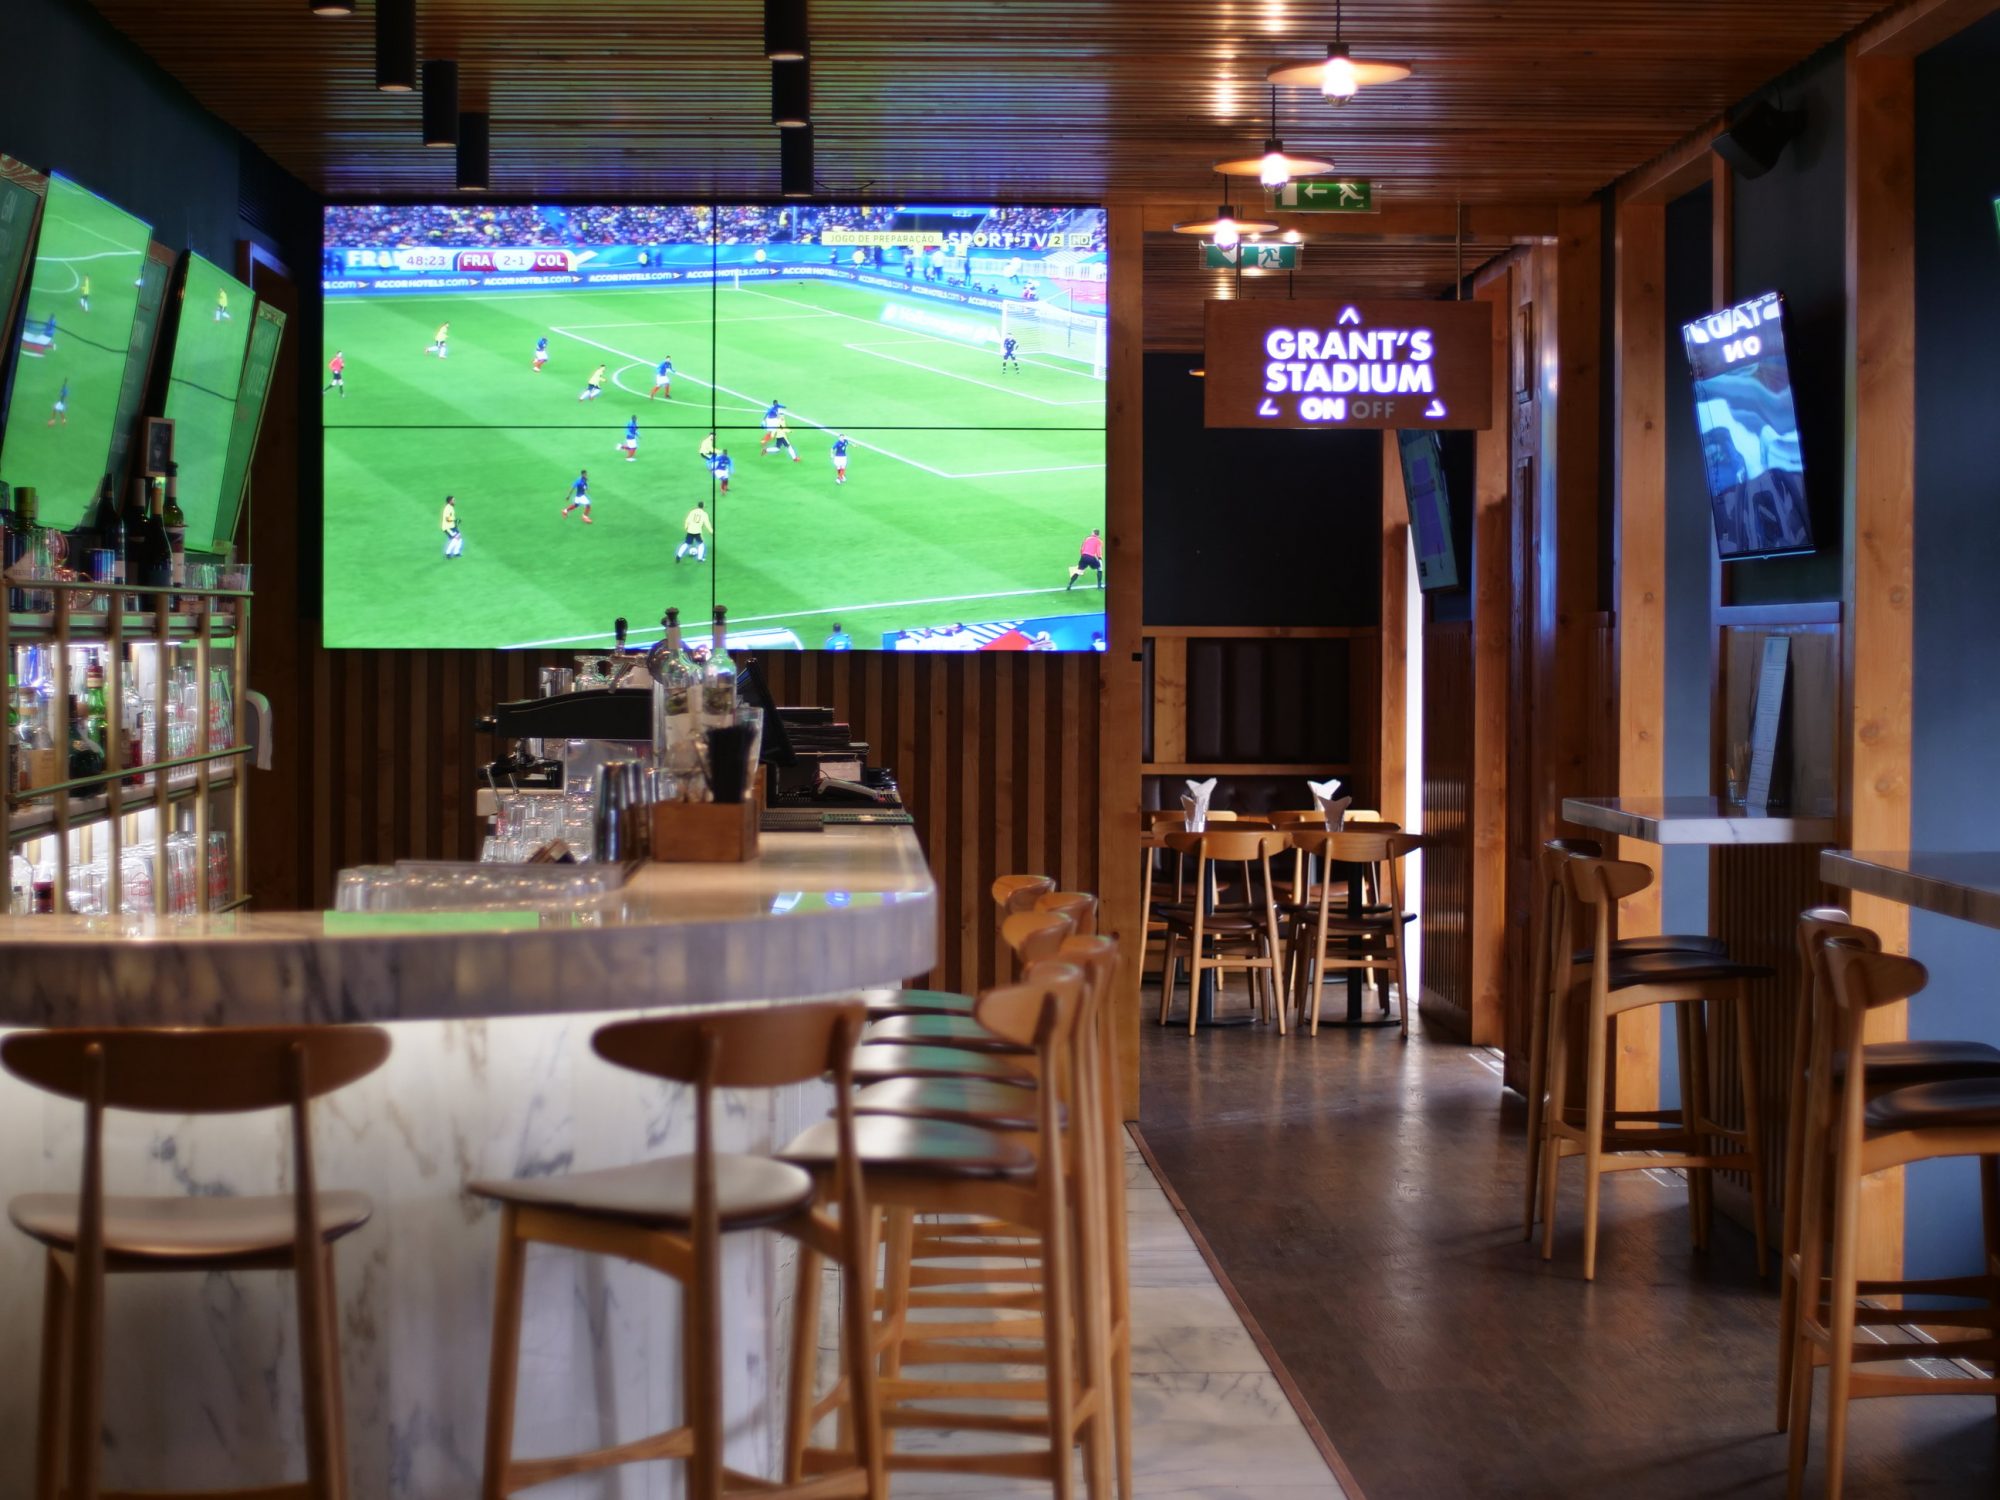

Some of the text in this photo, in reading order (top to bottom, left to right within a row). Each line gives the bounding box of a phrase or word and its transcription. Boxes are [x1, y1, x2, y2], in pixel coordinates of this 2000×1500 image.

[831, 234, 856, 243] JOGO
[858, 234, 870, 243] DE
[406, 256, 446, 266] 48:23
[463, 254, 491, 267] FRA
[536, 254, 565, 267] COL
[1266, 330, 1433, 361] GRANT'S
[1265, 362, 1434, 393] STADIUM
[1300, 396, 1395, 420] ON OFF
